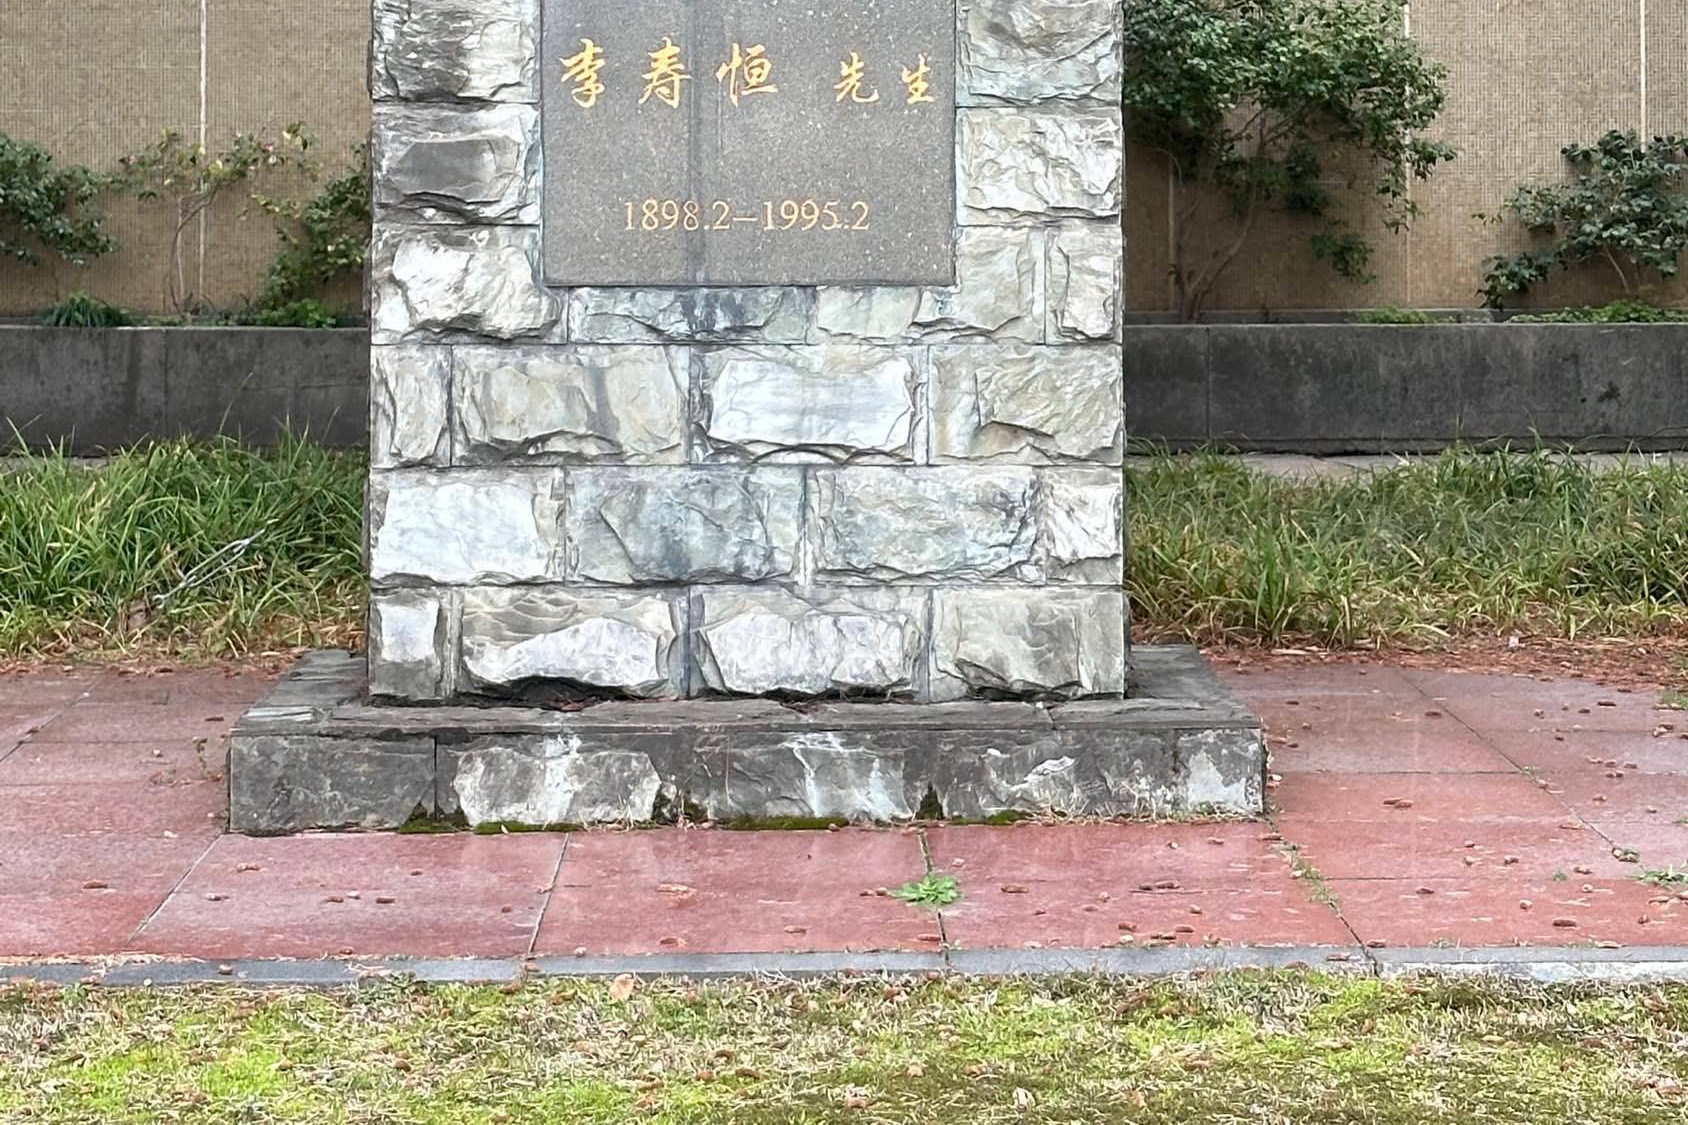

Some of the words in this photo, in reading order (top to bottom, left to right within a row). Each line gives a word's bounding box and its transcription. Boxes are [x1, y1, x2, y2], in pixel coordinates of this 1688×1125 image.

[559, 36, 779, 109] 李寿恒
[833, 51, 936, 106] 先生
